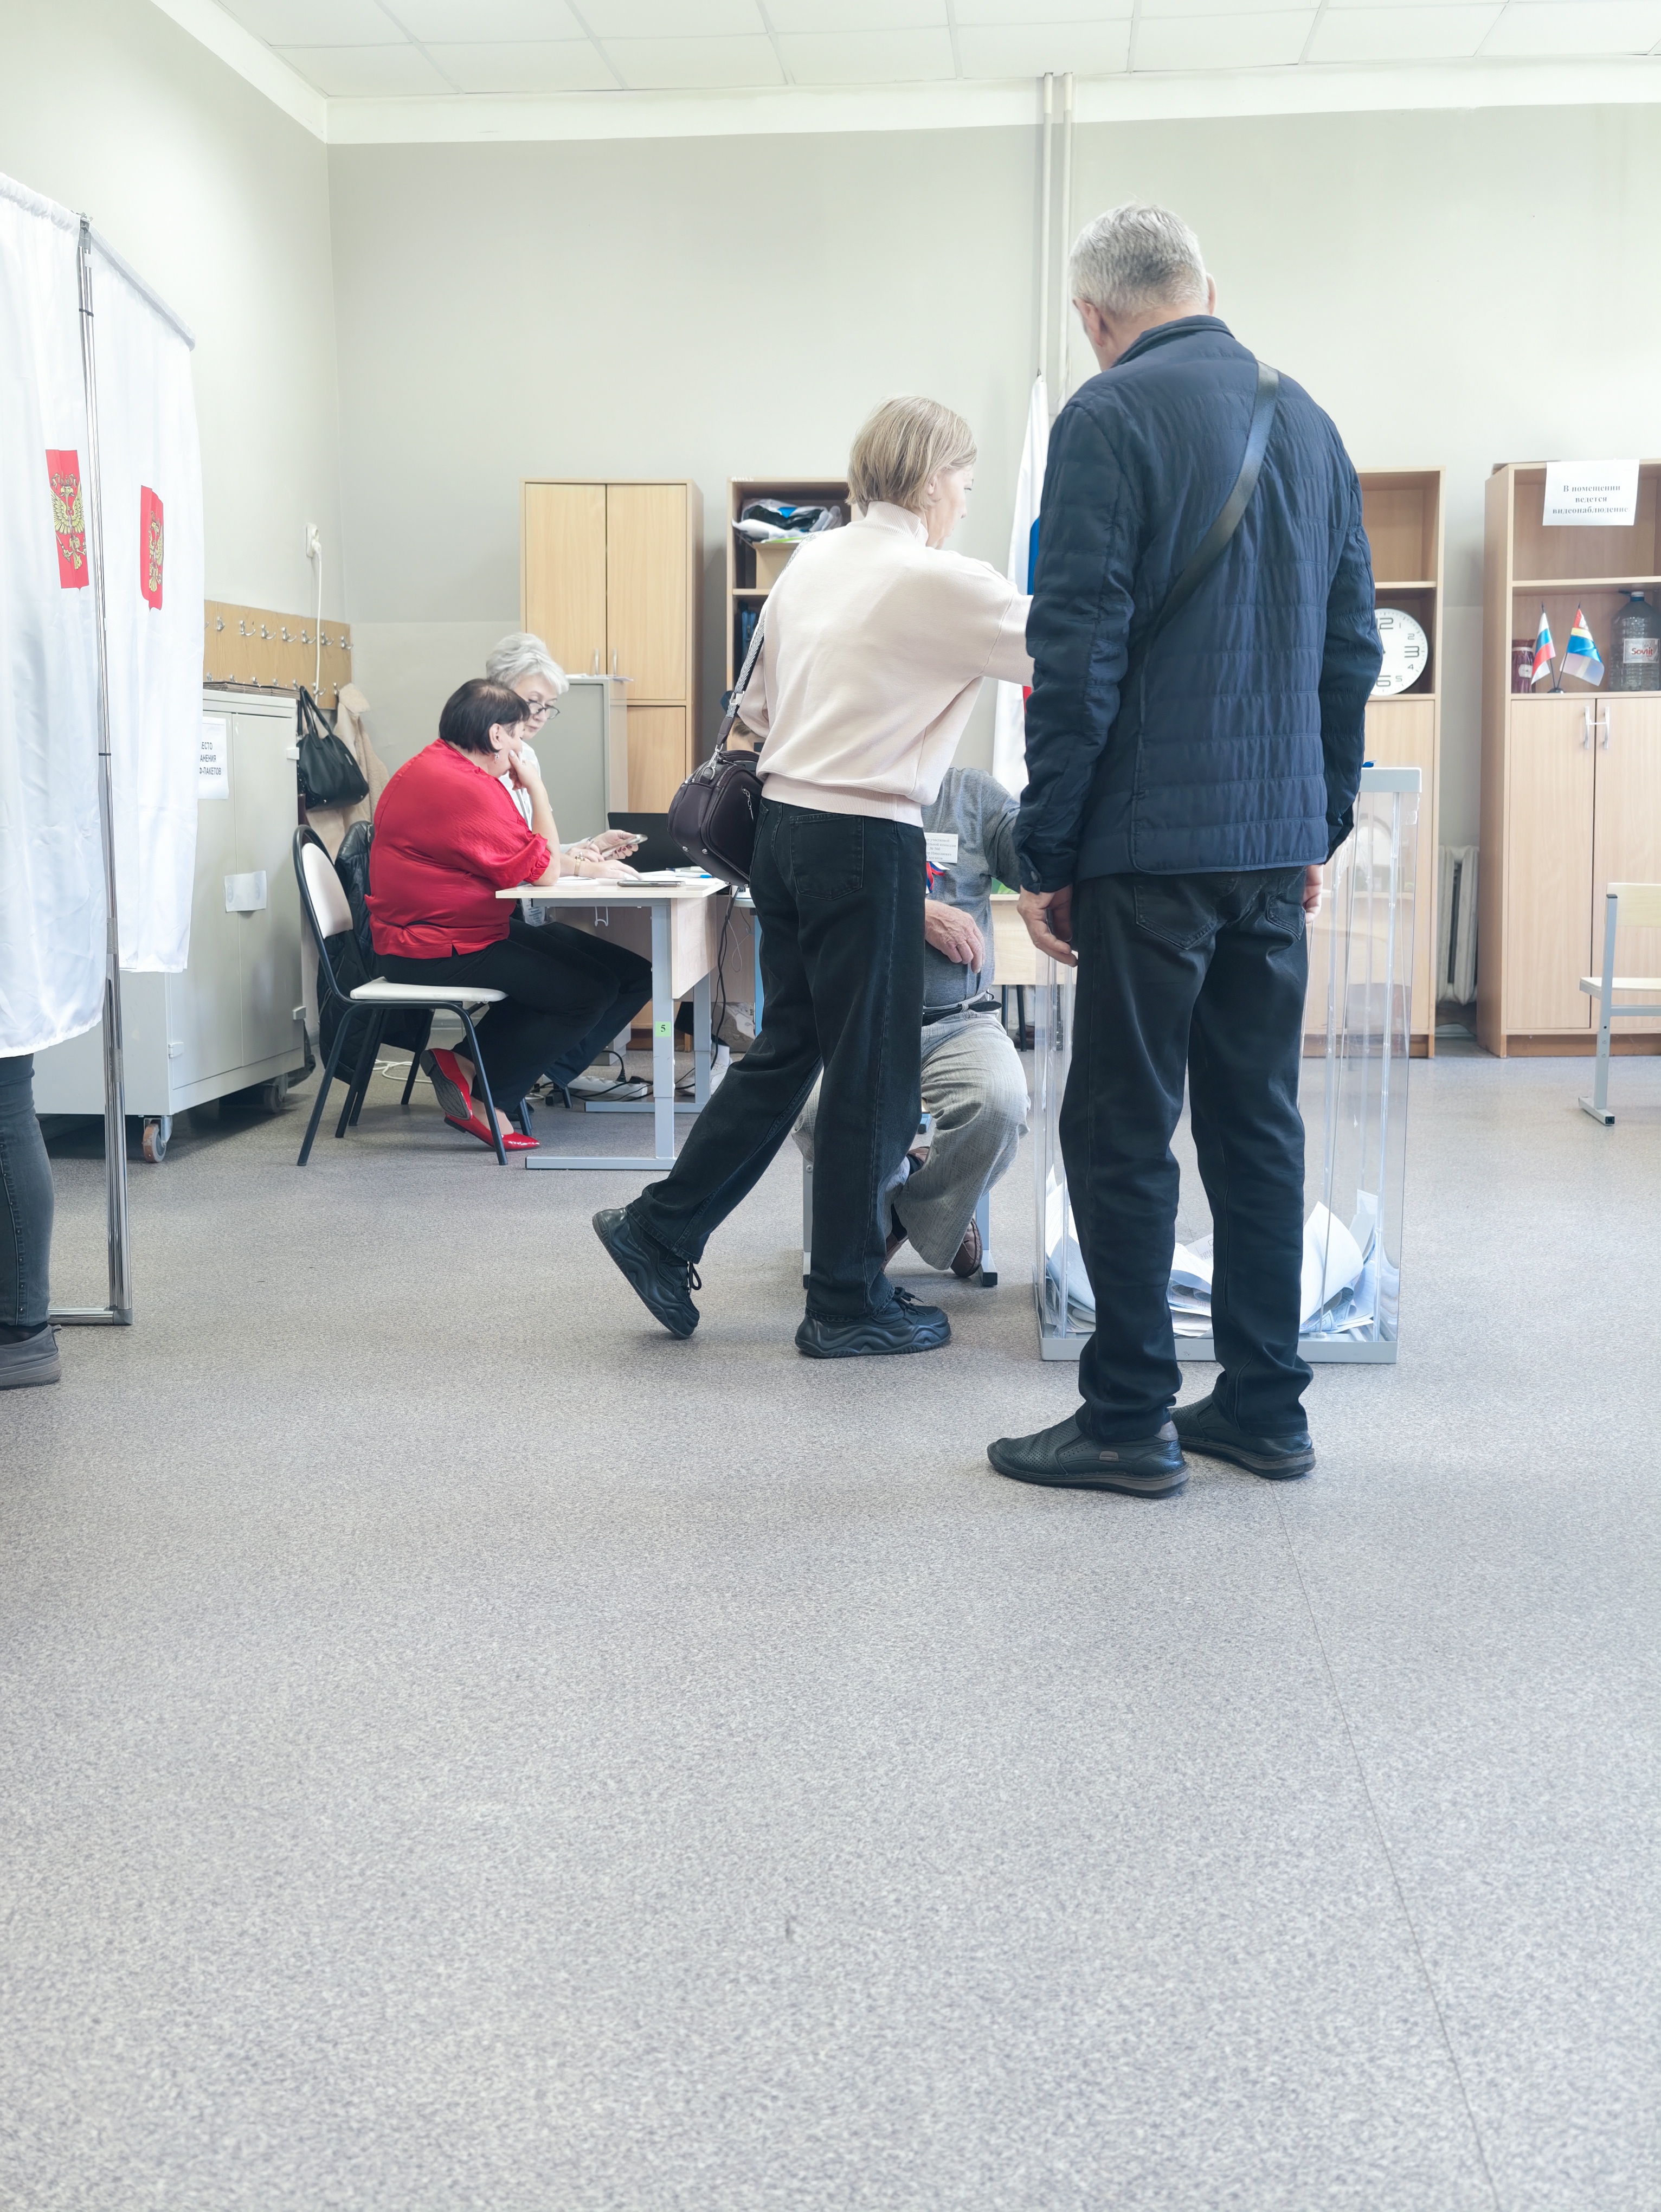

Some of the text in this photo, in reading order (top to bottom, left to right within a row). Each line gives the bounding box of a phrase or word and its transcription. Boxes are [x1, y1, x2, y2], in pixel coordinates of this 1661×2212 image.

[1553, 506, 1628, 515] видеонаблюдение
[1404, 646, 1420, 658] 3
[1376, 676, 1391, 687] 6
[201, 742, 213, 750] ЕСТО
[200, 754, 216, 762] АНЕНИЯ
[199, 767, 221, 775] Ф-ПАКЕТОВ
[660, 1024, 666, 1032] 5
